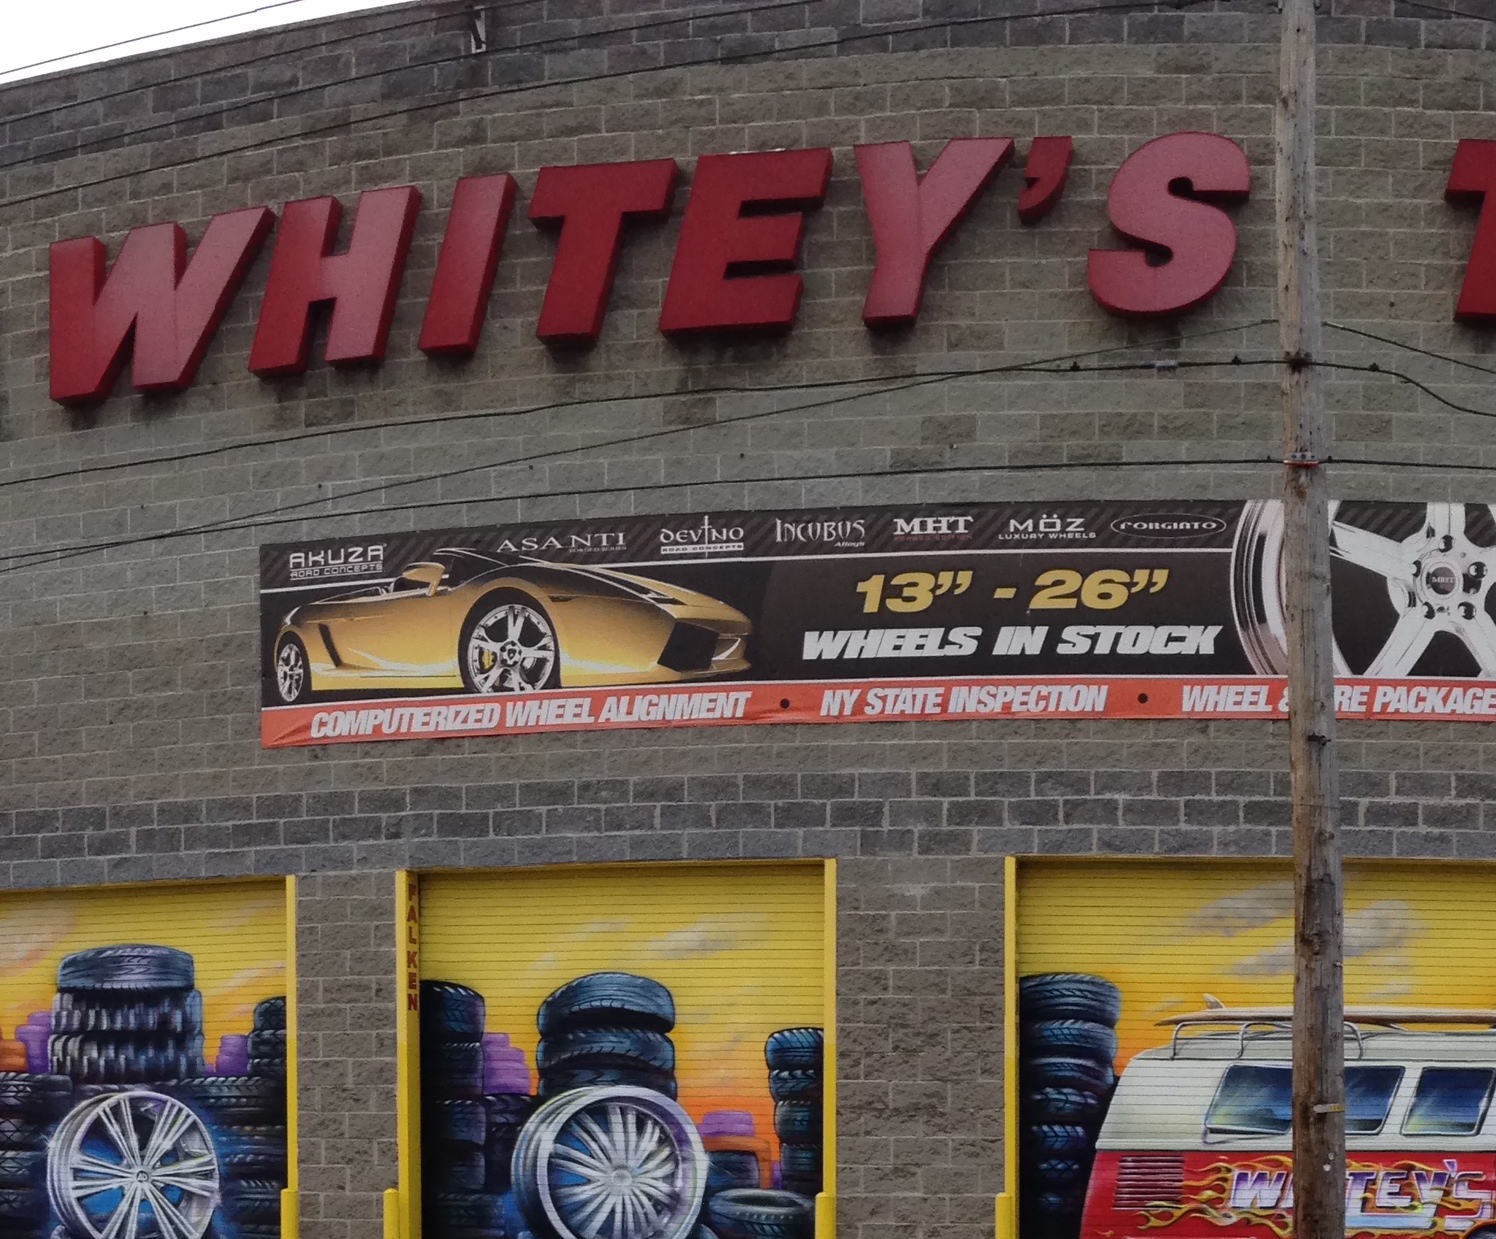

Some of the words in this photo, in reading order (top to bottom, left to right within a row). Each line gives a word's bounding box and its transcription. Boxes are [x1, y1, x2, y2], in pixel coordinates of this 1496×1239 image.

[50, 130, 1252, 407] WHITEY'S
[775, 518, 865, 542] INCUBUS
[893, 515, 973, 535] MHT
[497, 532, 626, 552] ASANTI
[290, 545, 384, 568] AKUZA
[290, 568, 320, 579] ROAD
[324, 563, 383, 575] CONCEPTS
[803, 627, 982, 660] WHEELS
[992, 625, 1047, 656] IN
[1056, 624, 1223, 655] STOCK
[820, 690, 856, 717] NY
[865, 686, 944, 715] STATE
[947, 684, 1109, 714] INSPECTION
[1181, 685, 1273, 712] WHEEL
[1334, 685, 1371, 712] RE
[310, 702, 502, 738] COMPUTERIZED
[504, 697, 598, 728] WHEEL
[599, 691, 752, 723] ALIGNMENT
[407, 883, 419, 1012] FALKEN
